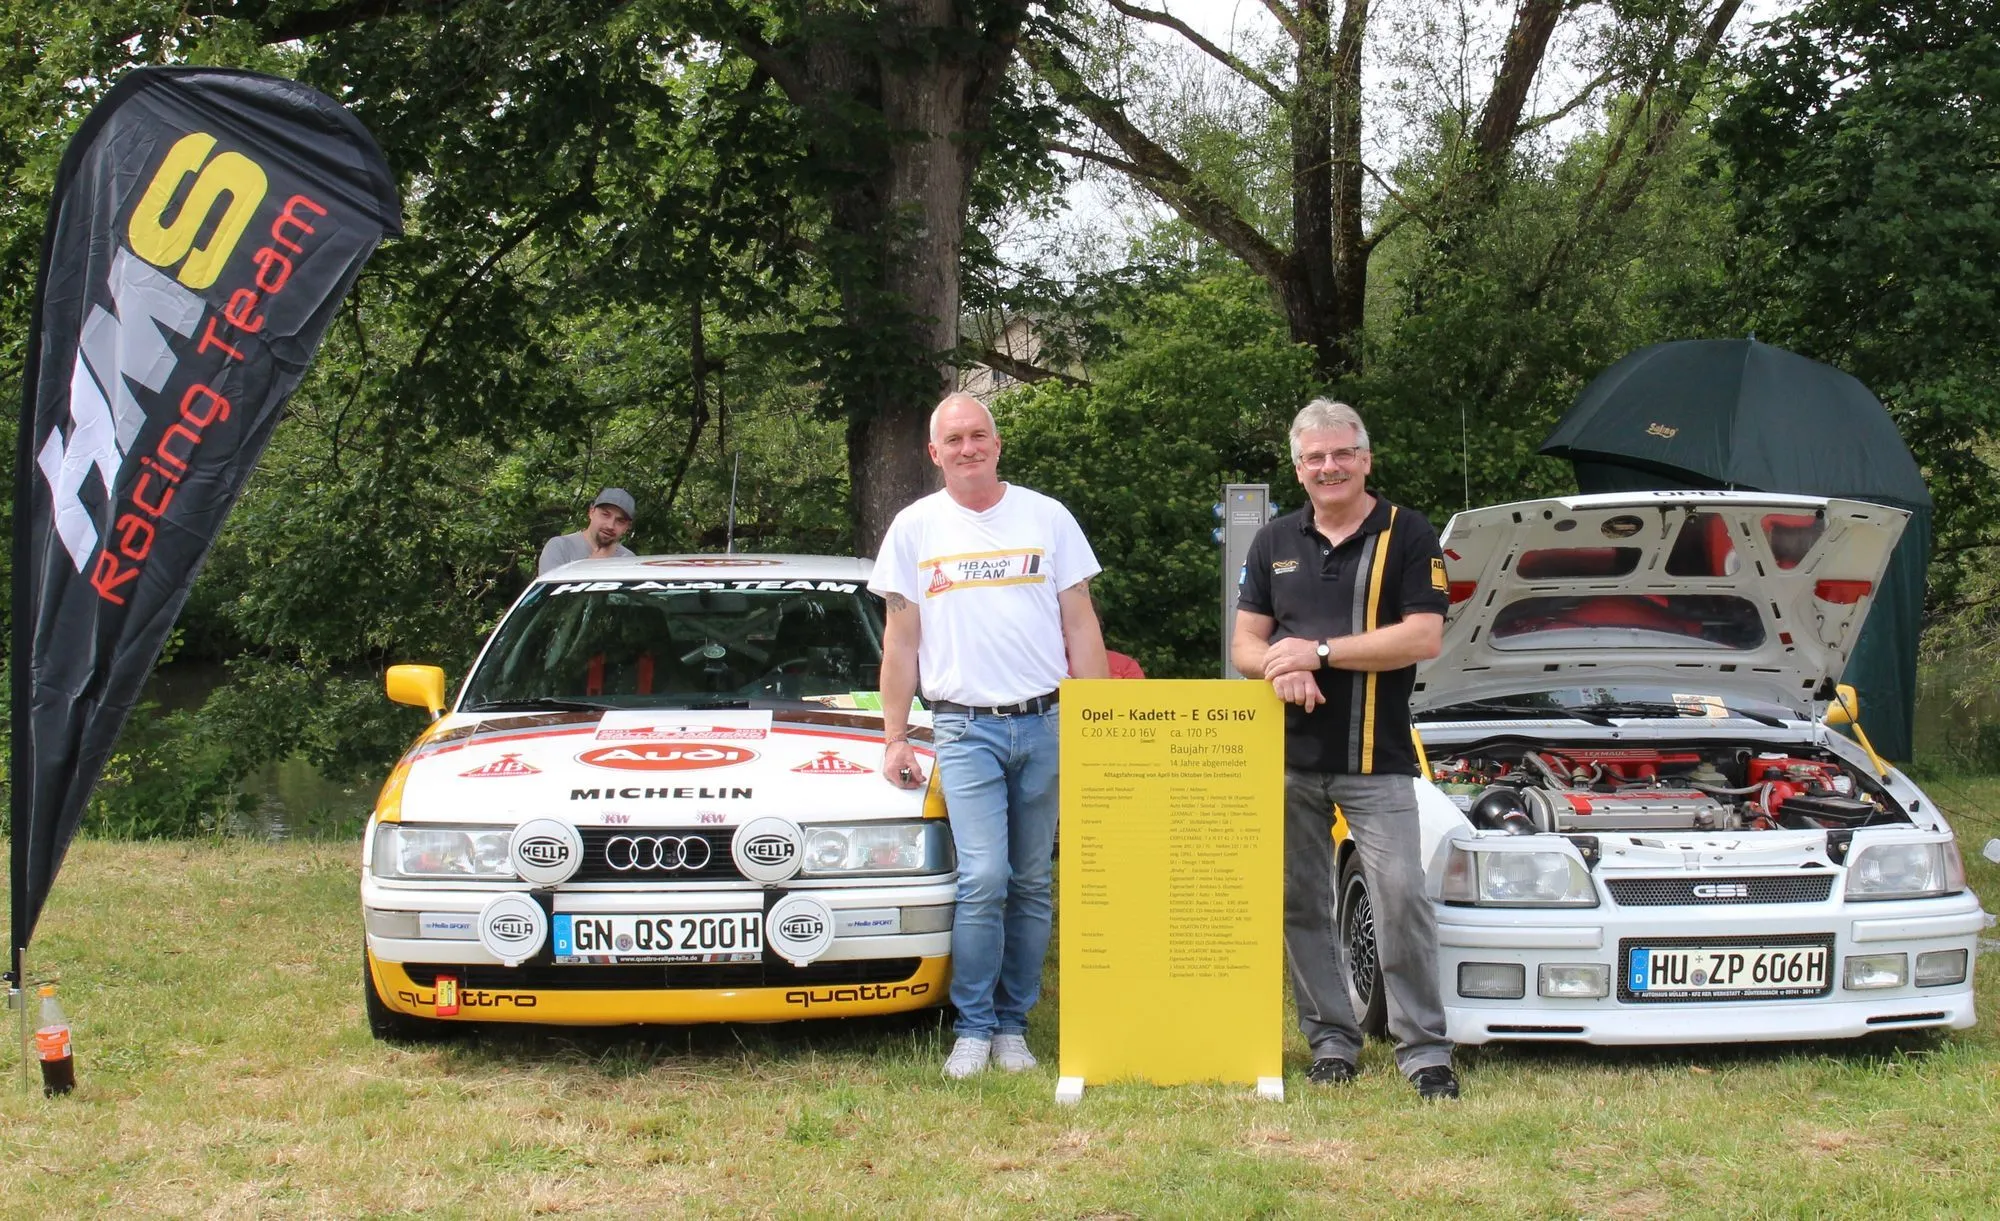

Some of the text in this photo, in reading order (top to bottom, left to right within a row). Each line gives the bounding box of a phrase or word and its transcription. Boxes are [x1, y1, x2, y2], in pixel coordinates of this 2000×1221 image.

[37, 132, 268, 574] HMS
[90, 194, 328, 605] Racing Team
[958, 559, 1011, 571] HB Audi
[964, 568, 1005, 580] TEAM
[550, 580, 859, 596] HB Audi TEAM
[1082, 709, 1113, 723] Opel
[1129, 709, 1176, 721] Kadett
[1192, 709, 1200, 721] E
[1207, 709, 1228, 721] GSi
[1232, 709, 1256, 721] 16V
[1082, 728, 1156, 738] C 20 XE 2.0 16V
[1187, 728, 1202, 738] 170
[1205, 728, 1217, 738] PS
[592, 748, 739, 762] Audi
[1170, 744, 1244, 756] Baujahr 7/1988
[482, 761, 524, 773] HB
[811, 759, 852, 770] HB
[1180, 759, 1200, 767] Jahre
[1202, 759, 1247, 769] abgemeldet
[571, 787, 753, 801] MICHELIN
[604, 813, 631, 824] KW
[700, 813, 726, 824] KW
[522, 846, 570, 860] HELLA
[747, 842, 795, 857] HELLA
[493, 922, 534, 936] HELLA
[574, 919, 613, 951] GN
[635, 918, 673, 951] QS
[783, 921, 824, 935] HELLA
[558, 939, 567, 949] D
[1651, 951, 1824, 985] HU ZP 606H
[1635, 973, 1642, 984] D
[398, 990, 537, 1008] quttro
[785, 982, 930, 1008] quattro
